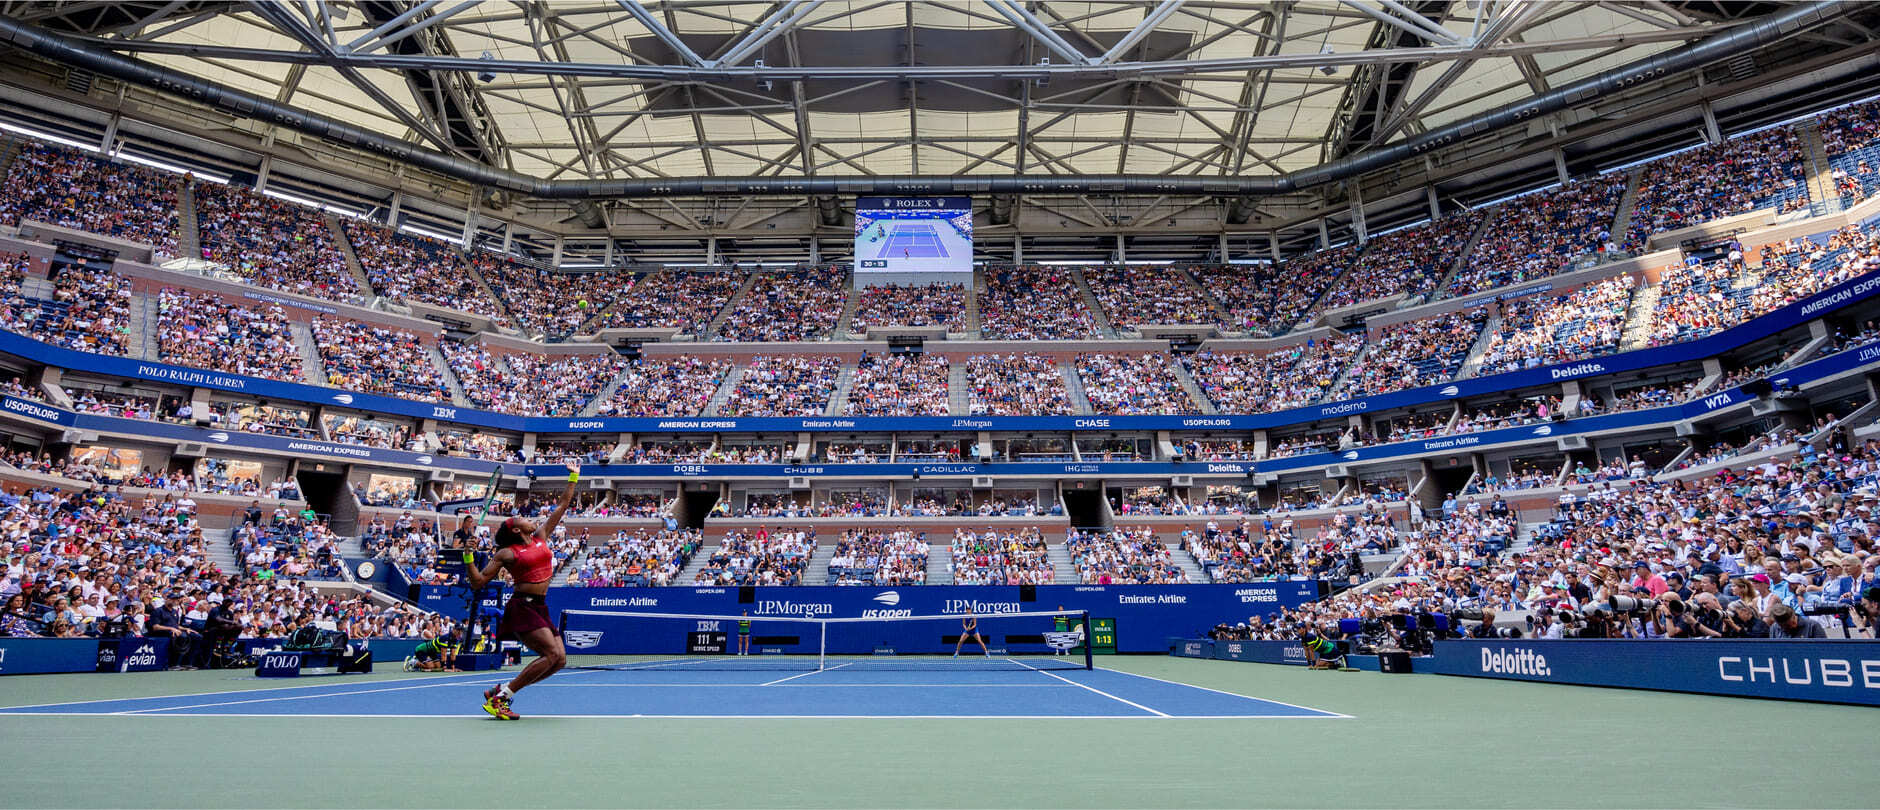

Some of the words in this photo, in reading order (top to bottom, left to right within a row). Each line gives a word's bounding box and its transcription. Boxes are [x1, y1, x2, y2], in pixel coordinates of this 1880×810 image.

[897, 199, 932, 208] ROLEX
[1801, 289, 1852, 316] AMERICAN
[138, 365, 167, 376] POLO
[169, 370, 204, 383] RALPH
[206, 376, 246, 389] LAUREN
[1551, 363, 1605, 379] Deloitte.
[1705, 393, 1732, 409] WTA
[5, 399, 60, 420] USOPEN.ORG
[433, 406, 456, 419] IBM
[1322, 402, 1367, 415] moderna
[802, 420, 831, 428] Emirates
[832, 420, 855, 428] Airline
[952, 419, 992, 429] J.P.Morgan
[1075, 419, 1111, 427] CHASE
[288, 442, 332, 453] AMERICAN
[333, 447, 370, 457] EXPRESS
[1424, 440, 1455, 450] Emirates
[1455, 436, 1479, 446] Airline
[1208, 464, 1244, 473] Deloitte.
[591, 597, 627, 606] Emirates
[628, 597, 658, 606] Airline
[1119, 594, 1156, 604] Emirates
[1157, 594, 1187, 604] Airline
[754, 600, 832, 618] J.P.Morgan
[942, 599, 1021, 616] J.P.Morgan
[696, 620, 720, 632] IBM
[697, 634, 710, 645] 111
[1096, 635, 1112, 644] 1:13
[129, 653, 156, 666] evian
[264, 655, 299, 669] POLO
[1481, 647, 1551, 676] Deloitte.
